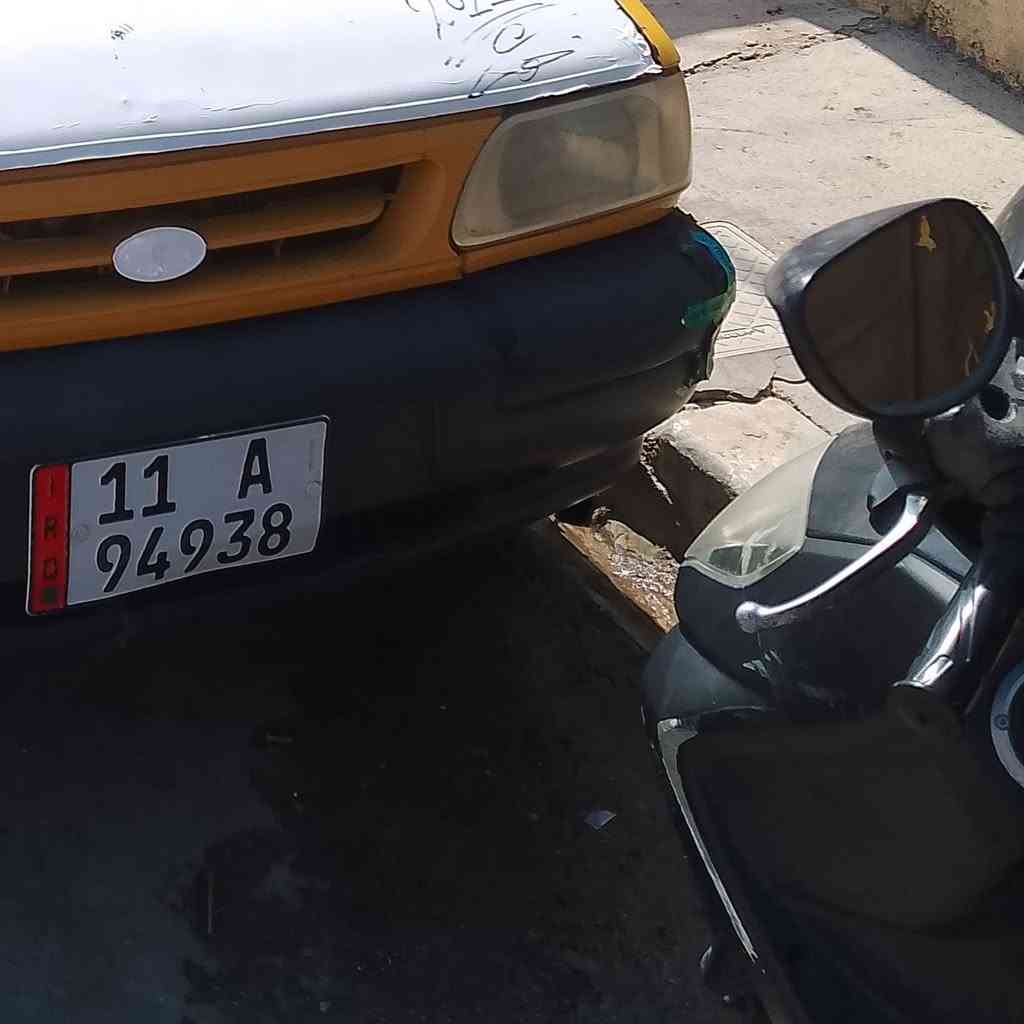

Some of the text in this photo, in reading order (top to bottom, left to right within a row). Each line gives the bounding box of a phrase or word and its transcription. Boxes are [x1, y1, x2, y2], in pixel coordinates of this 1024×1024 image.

[97, 437, 273, 525] 11 A
[96, 502, 293, 593] 94938
